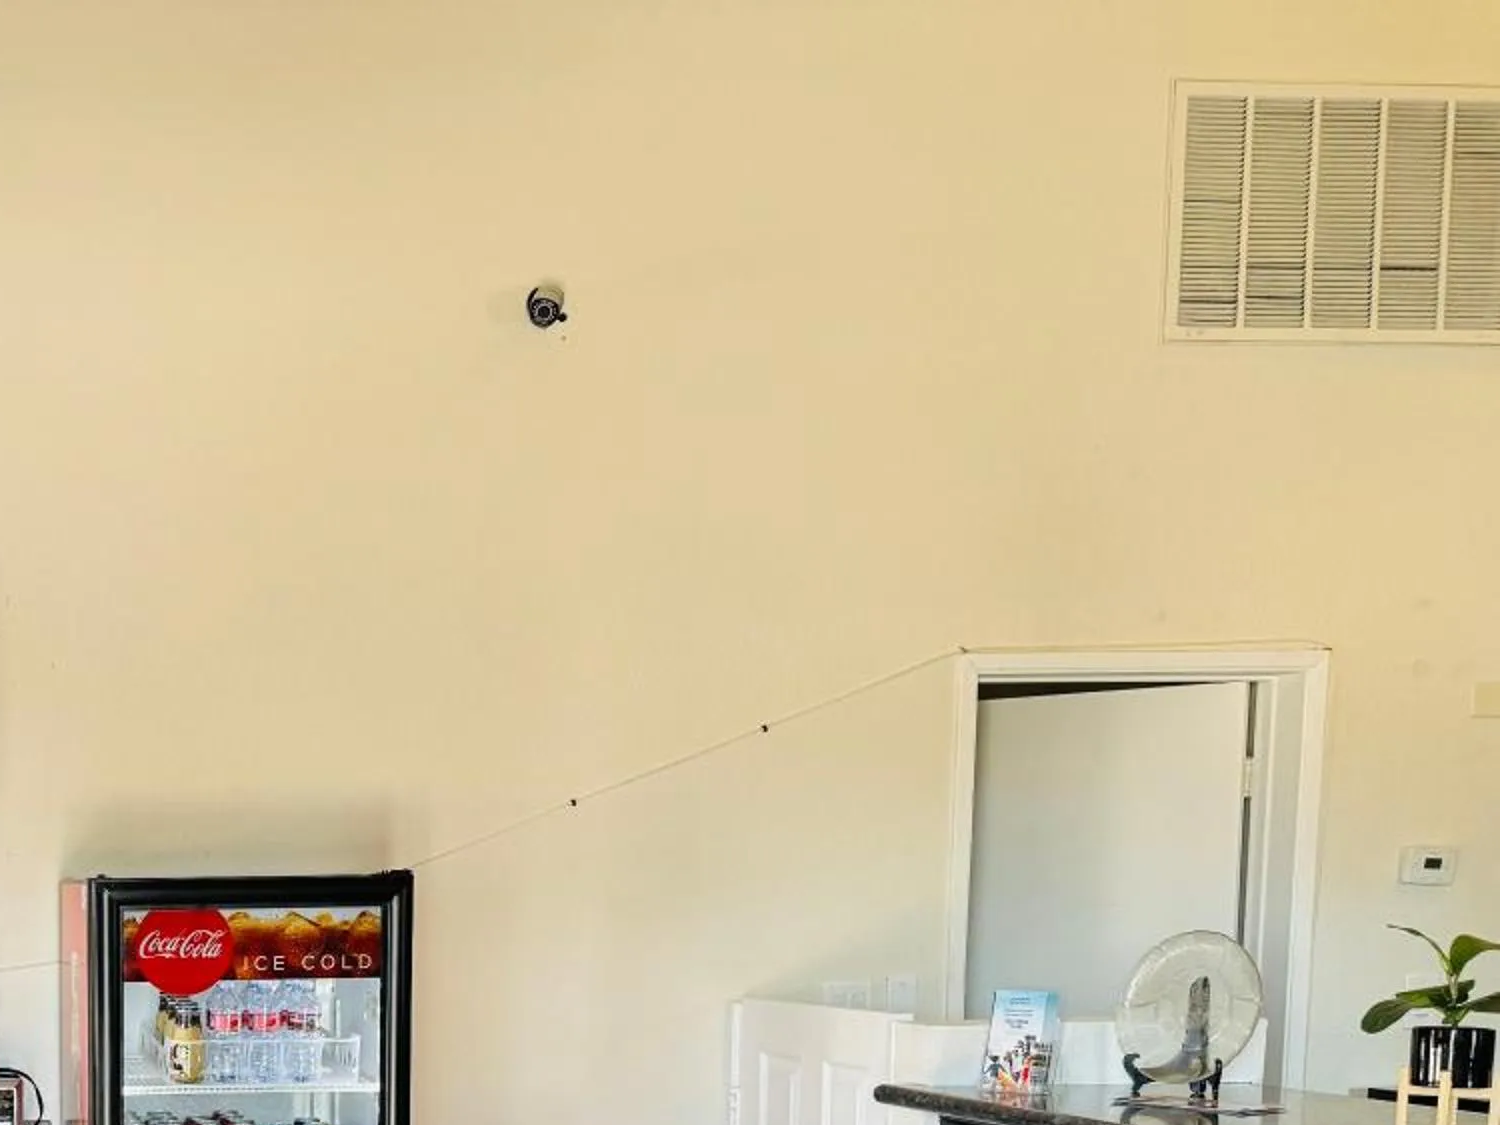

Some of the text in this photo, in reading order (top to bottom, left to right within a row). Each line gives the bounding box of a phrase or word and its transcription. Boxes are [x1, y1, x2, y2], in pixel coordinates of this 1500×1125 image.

[139, 929, 229, 959] Coca-Cola
[242, 953, 373, 972] ICE COLD
